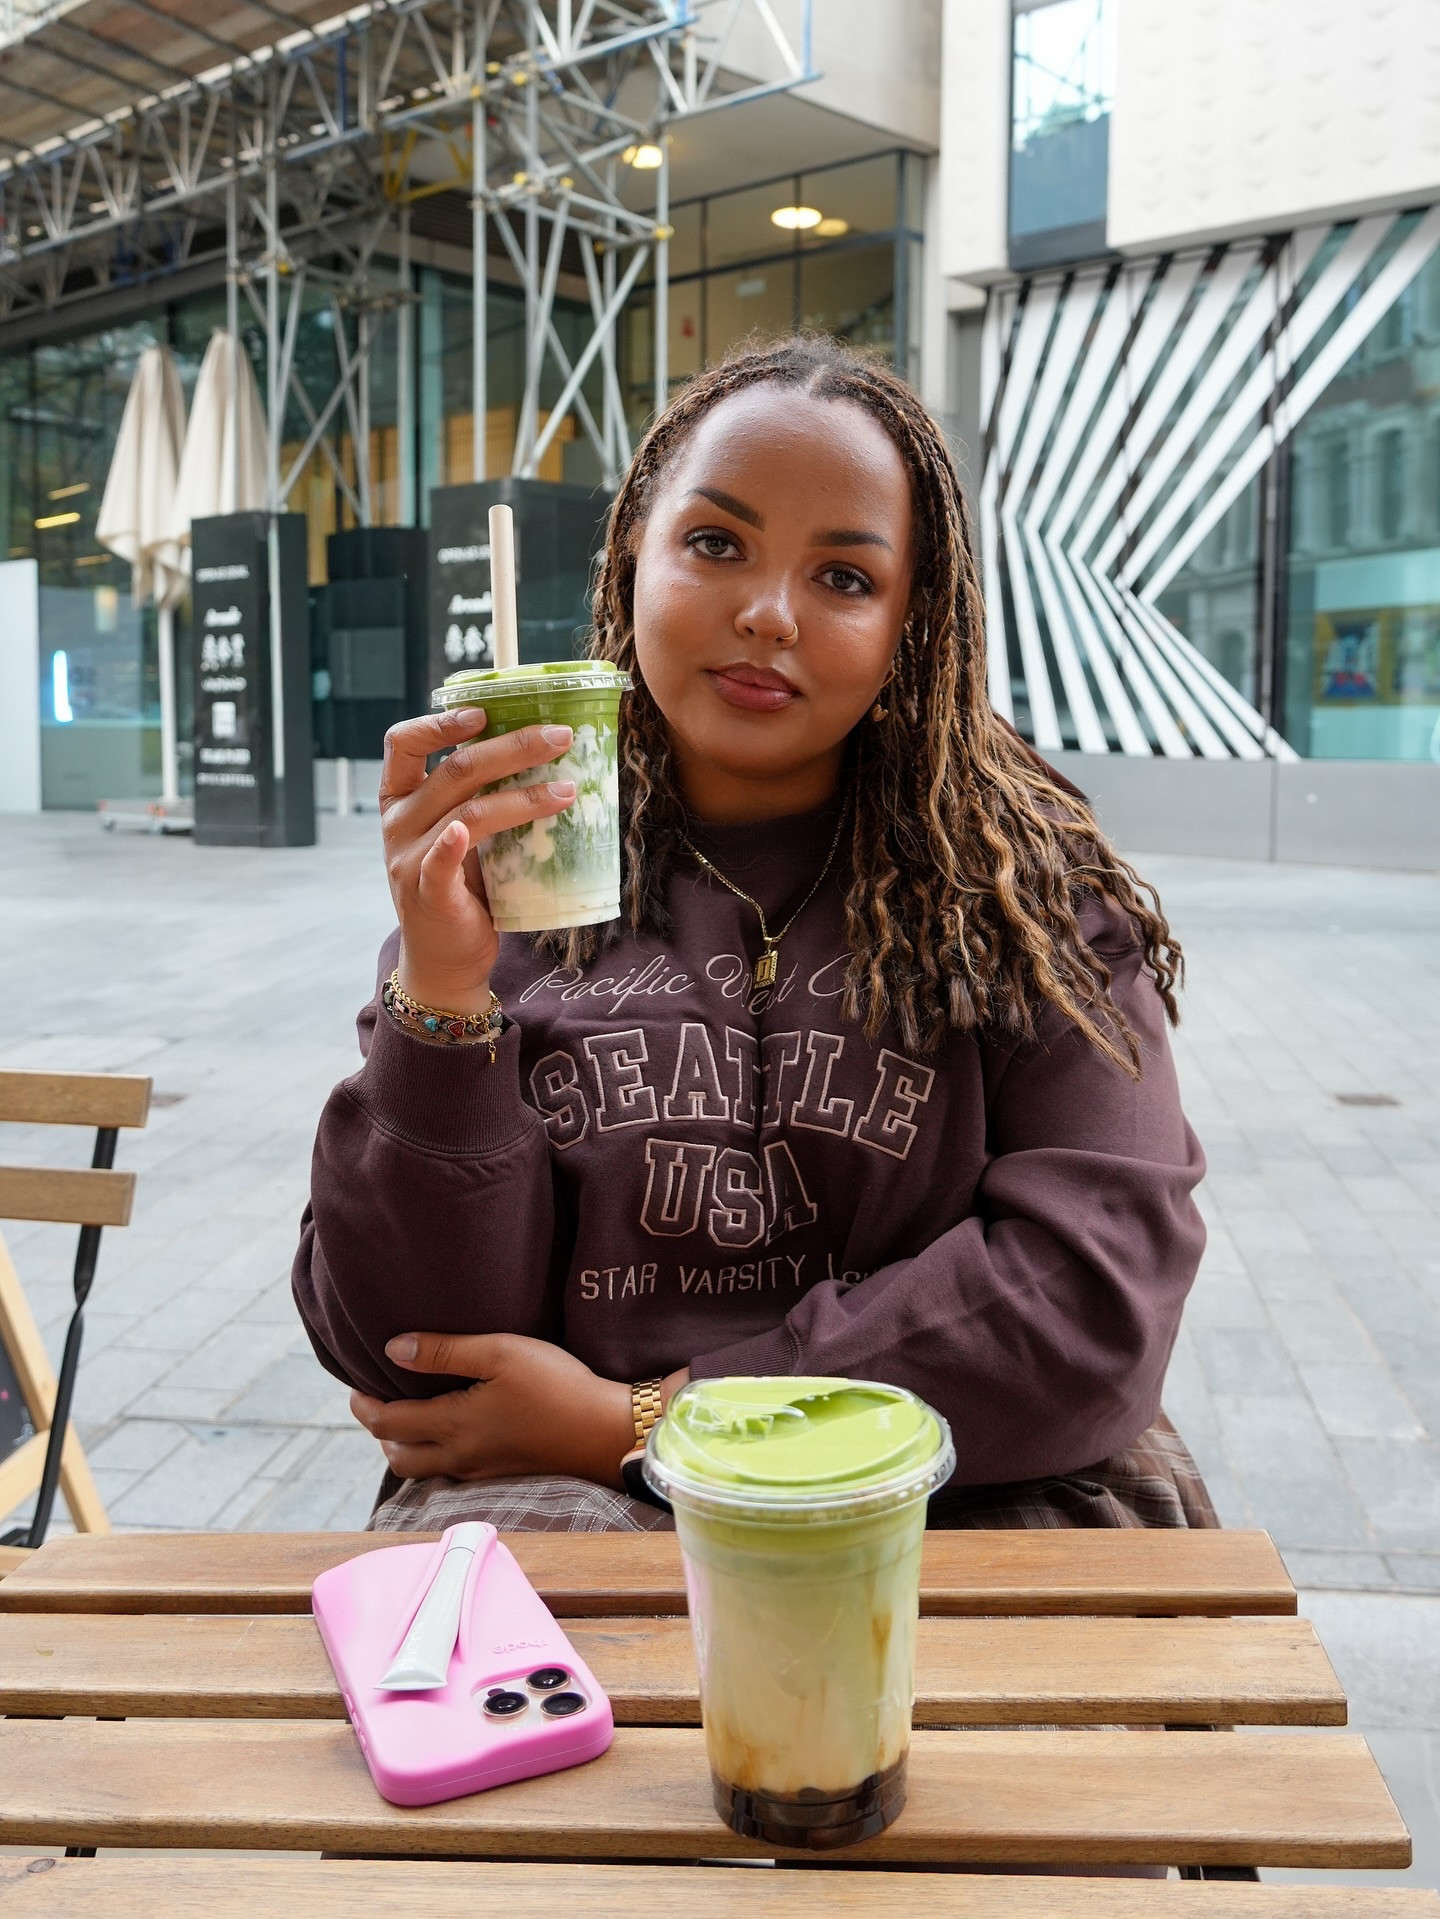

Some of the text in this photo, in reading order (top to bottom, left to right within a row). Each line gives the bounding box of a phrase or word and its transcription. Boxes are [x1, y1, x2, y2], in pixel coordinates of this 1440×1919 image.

[519, 954, 695, 1015] Pacific
[528, 1022, 936, 1161] SEATTLE
[639, 1137, 818, 1249] USA
[580, 1262, 658, 1300] STAR
[679, 1254, 807, 1295] VARSITY
